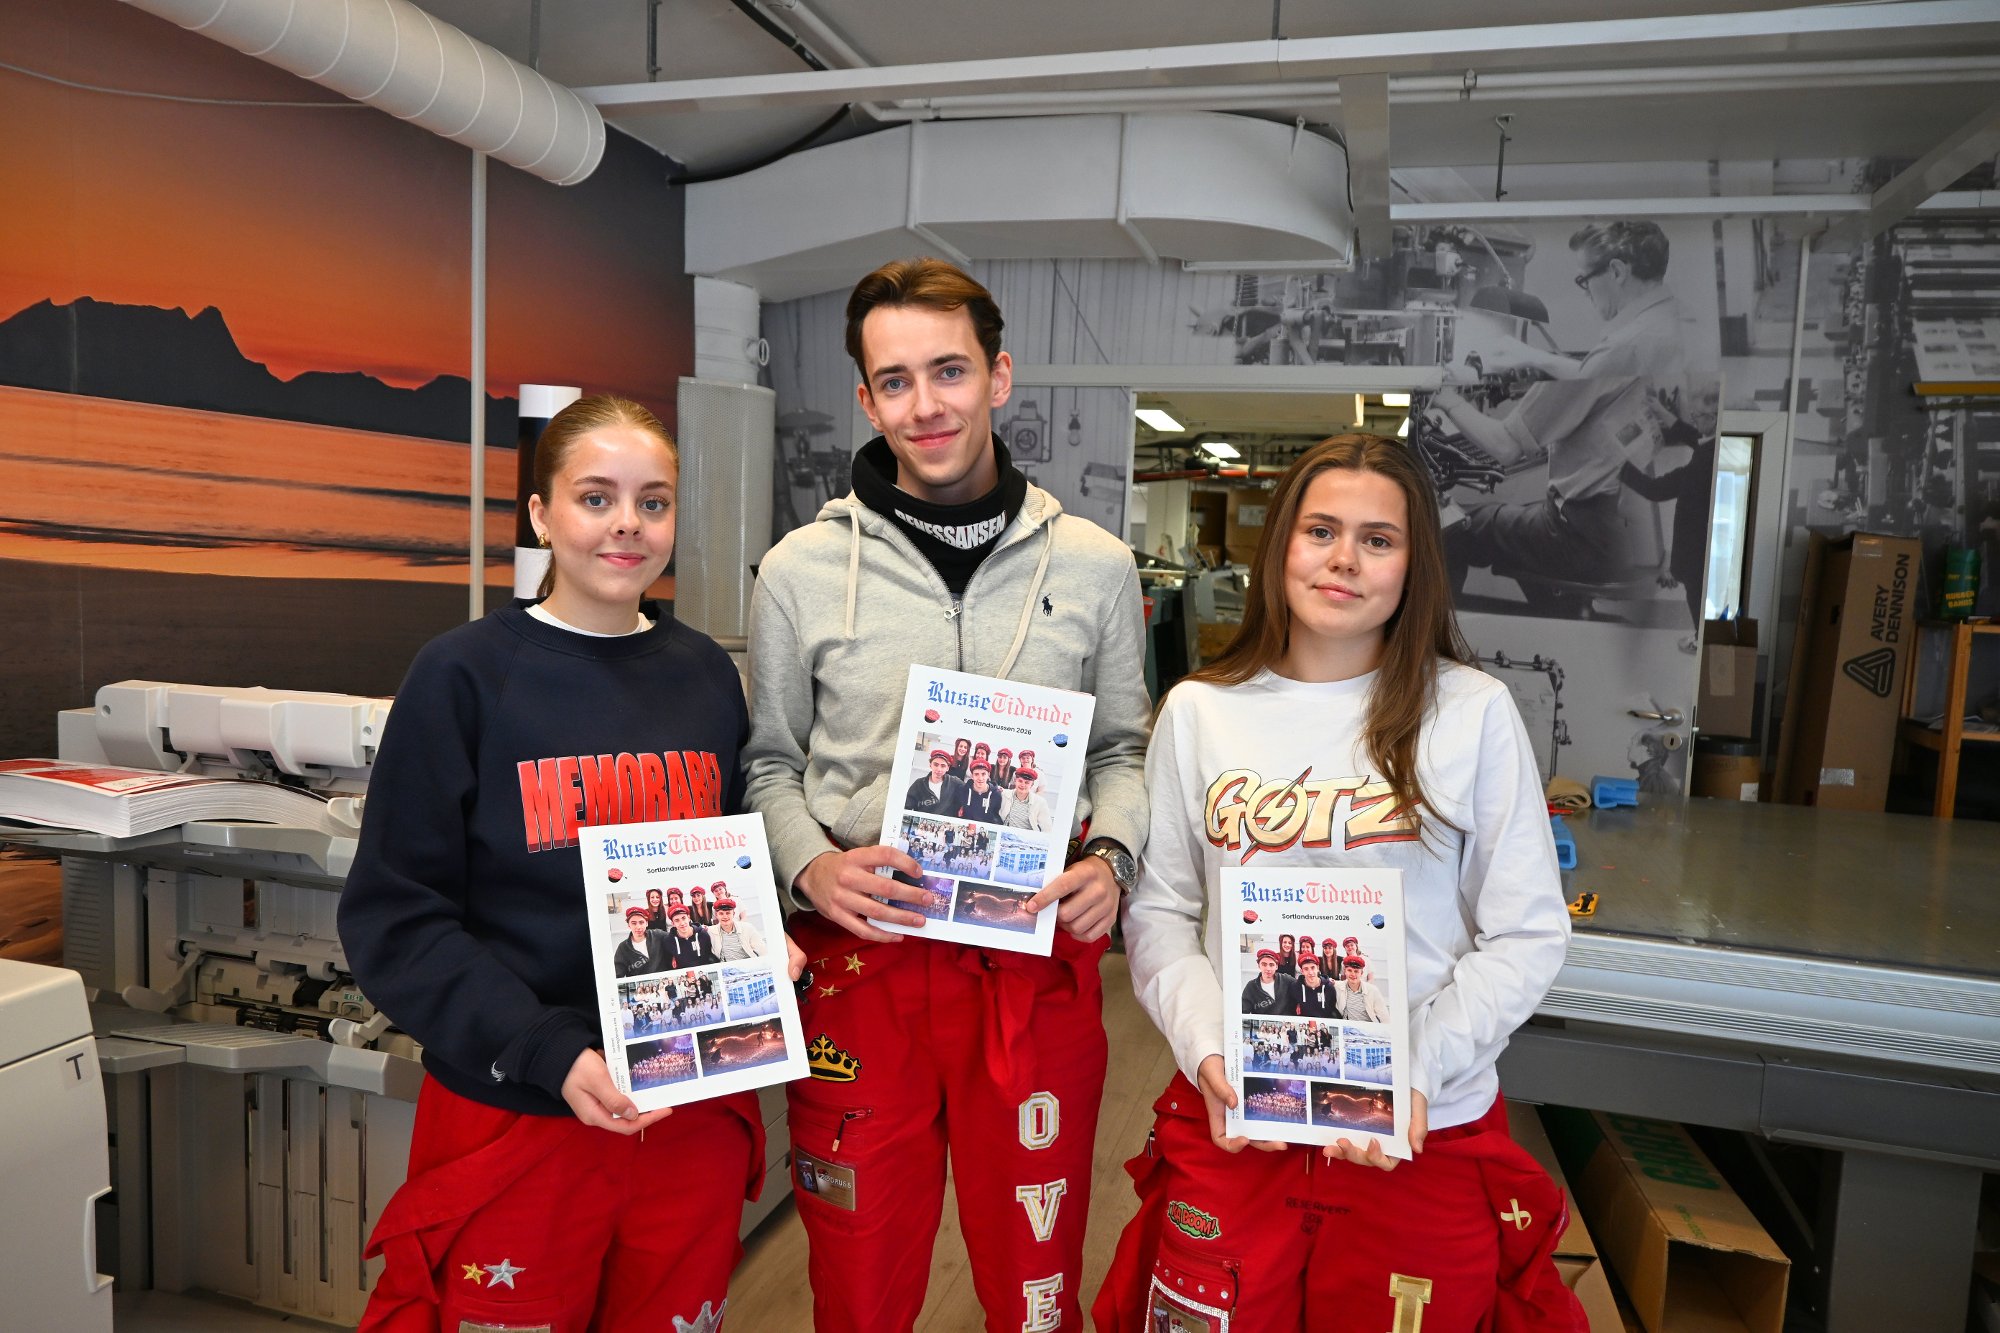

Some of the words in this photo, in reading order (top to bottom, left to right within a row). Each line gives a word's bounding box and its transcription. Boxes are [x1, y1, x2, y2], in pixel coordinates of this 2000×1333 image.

[1885, 553, 1910, 643] DENNISON
[1870, 584, 1890, 642] AVERY
[963, 718, 1016, 733] Sortlandsrussen
[1016, 727, 1032, 736] 2026
[646, 863, 699, 875] Sortlandsrussen
[700, 861, 716, 869] 2026
[1281, 913, 1334, 921] Sortlandsrussen
[66, 1052, 84, 1080] T
[1183, 1209, 1217, 1236] BOOM!
